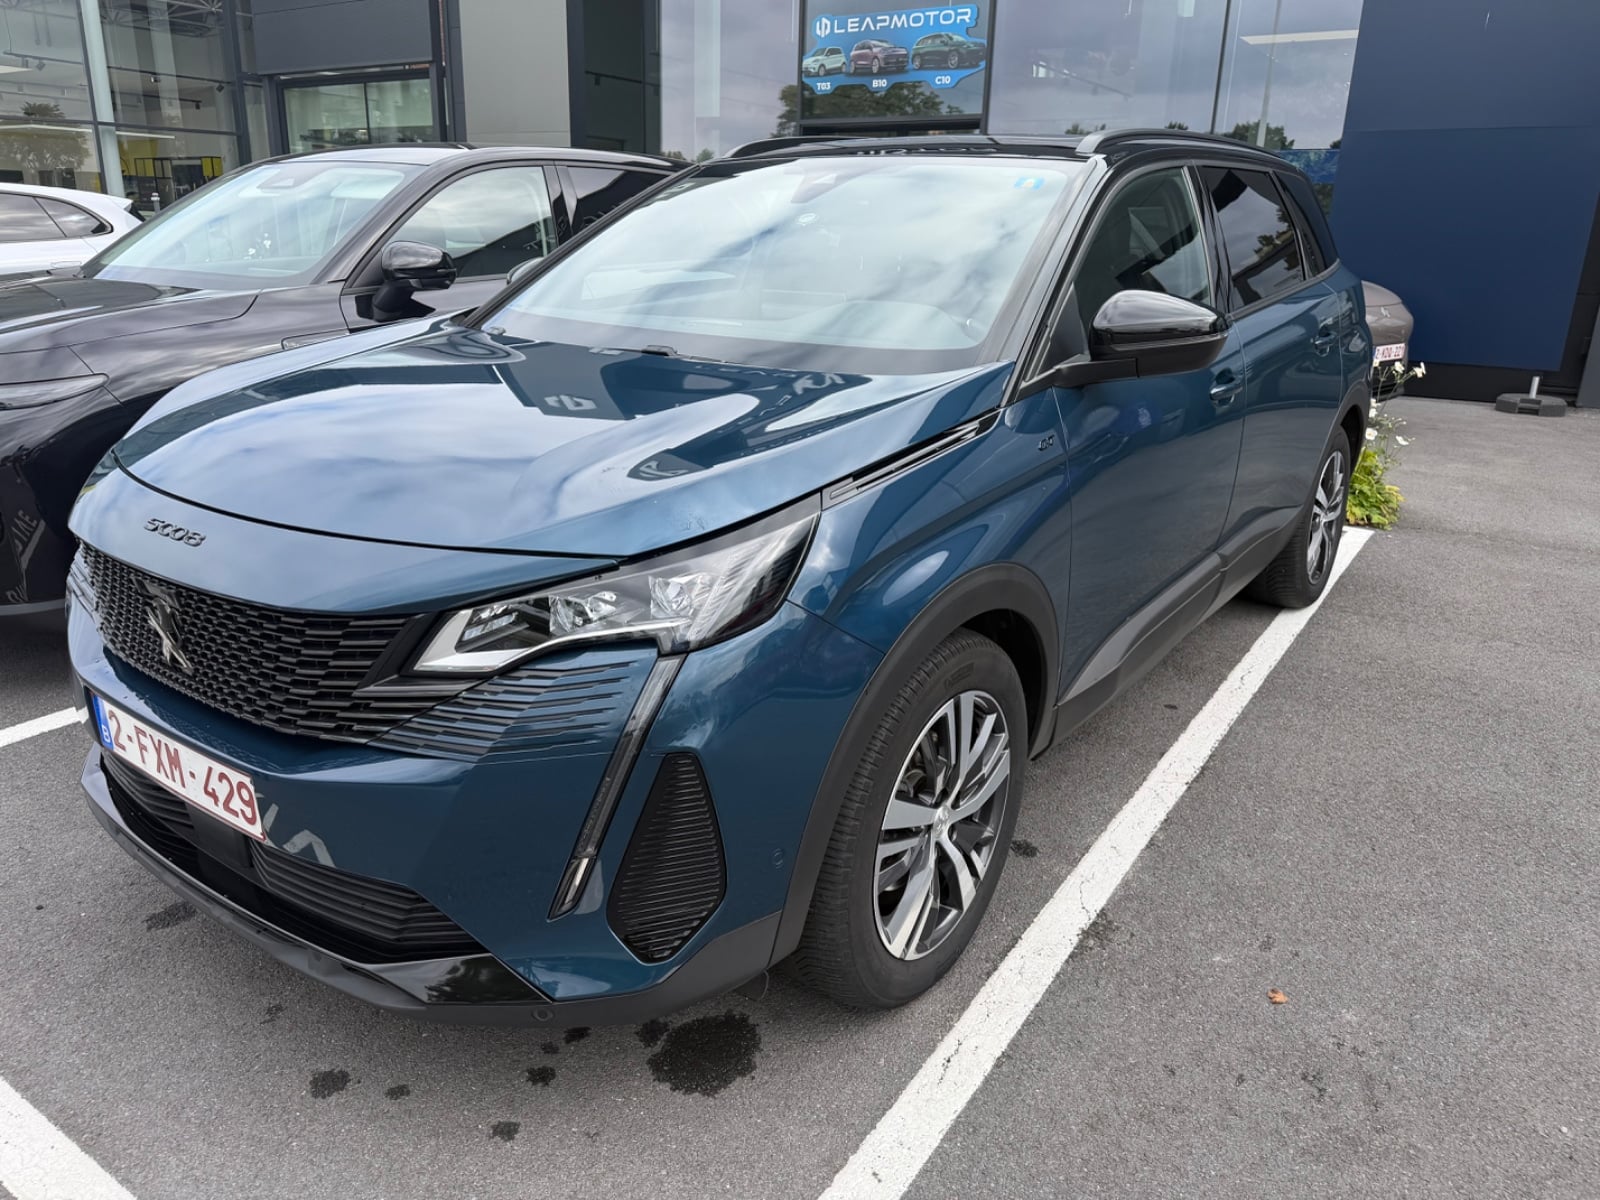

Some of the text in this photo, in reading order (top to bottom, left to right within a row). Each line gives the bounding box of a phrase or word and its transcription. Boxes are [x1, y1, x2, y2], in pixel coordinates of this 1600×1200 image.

[834, 8, 972, 34] LEAPMOTOR
[872, 79, 888, 88] B10
[935, 75, 951, 84] C10
[144, 518, 206, 548] 5008
[101, 725, 111, 743] B
[108, 709, 258, 826] 2-FXM-429
